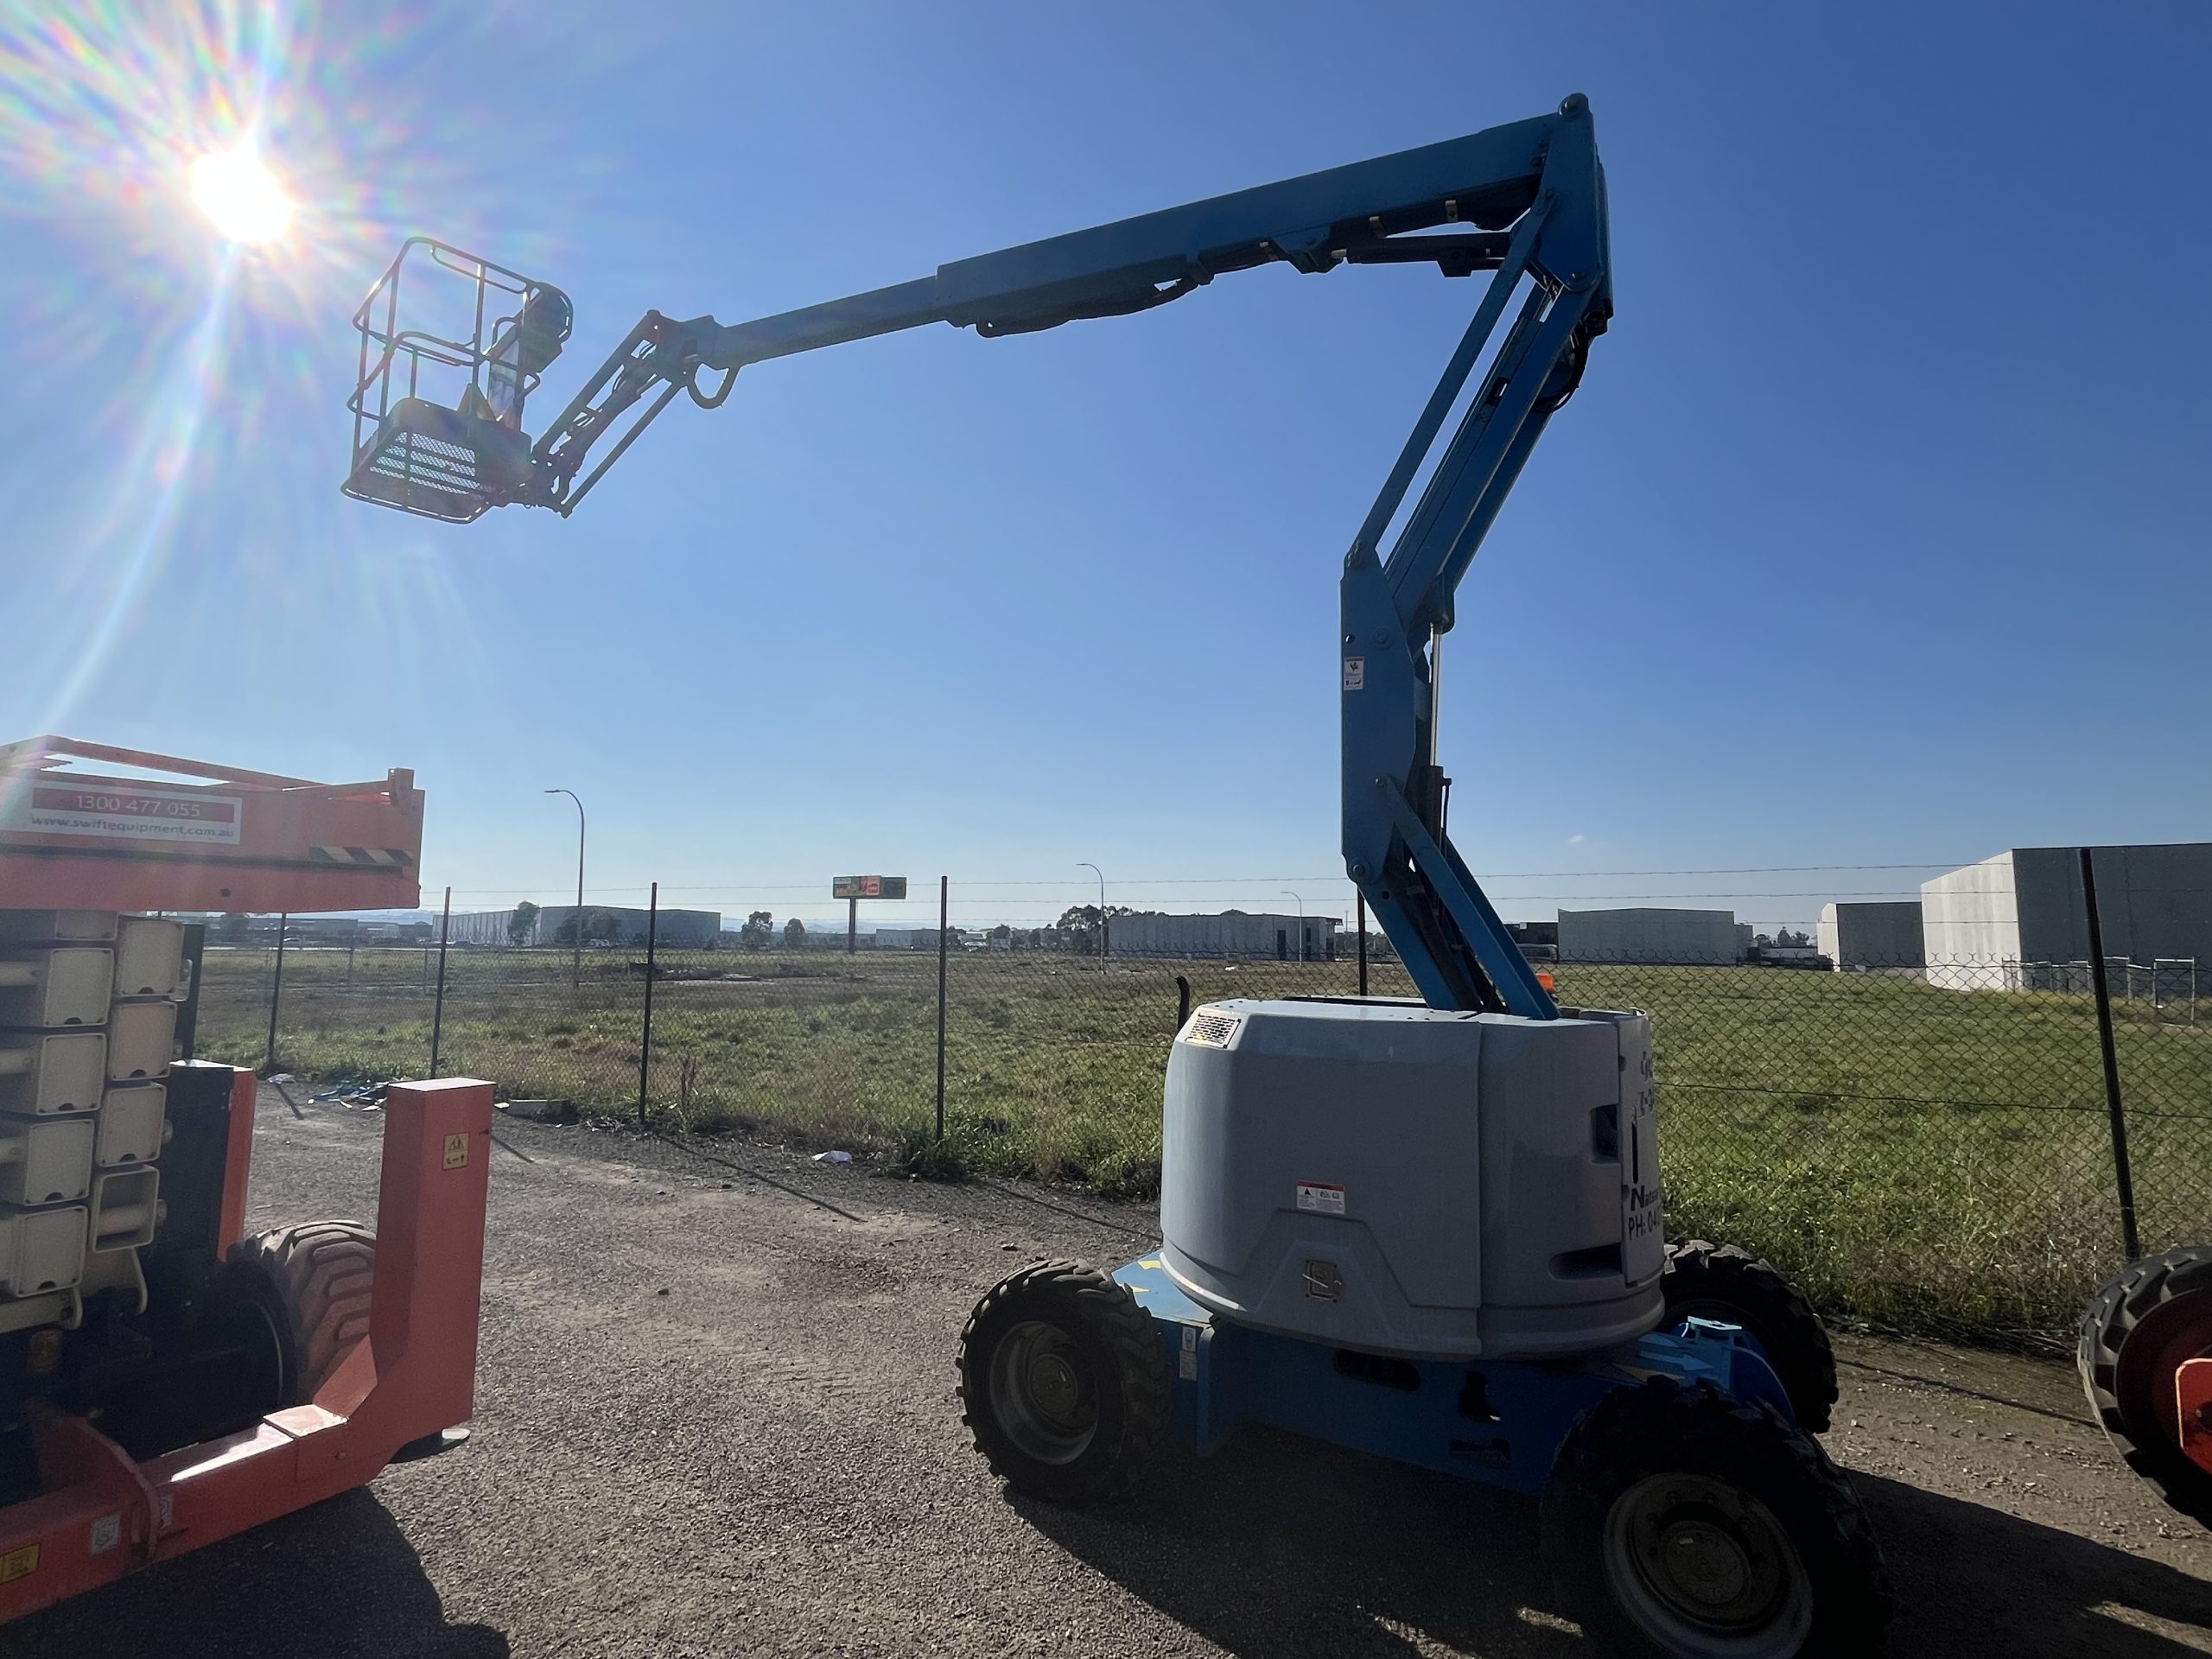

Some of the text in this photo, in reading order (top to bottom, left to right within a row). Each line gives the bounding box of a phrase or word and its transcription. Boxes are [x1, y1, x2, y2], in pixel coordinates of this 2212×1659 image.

[76, 795, 200, 817] 1300 477 055
[32, 817, 234, 837] www.swiftequipment.com.au
[1628, 1213, 1646, 1241] PH:
